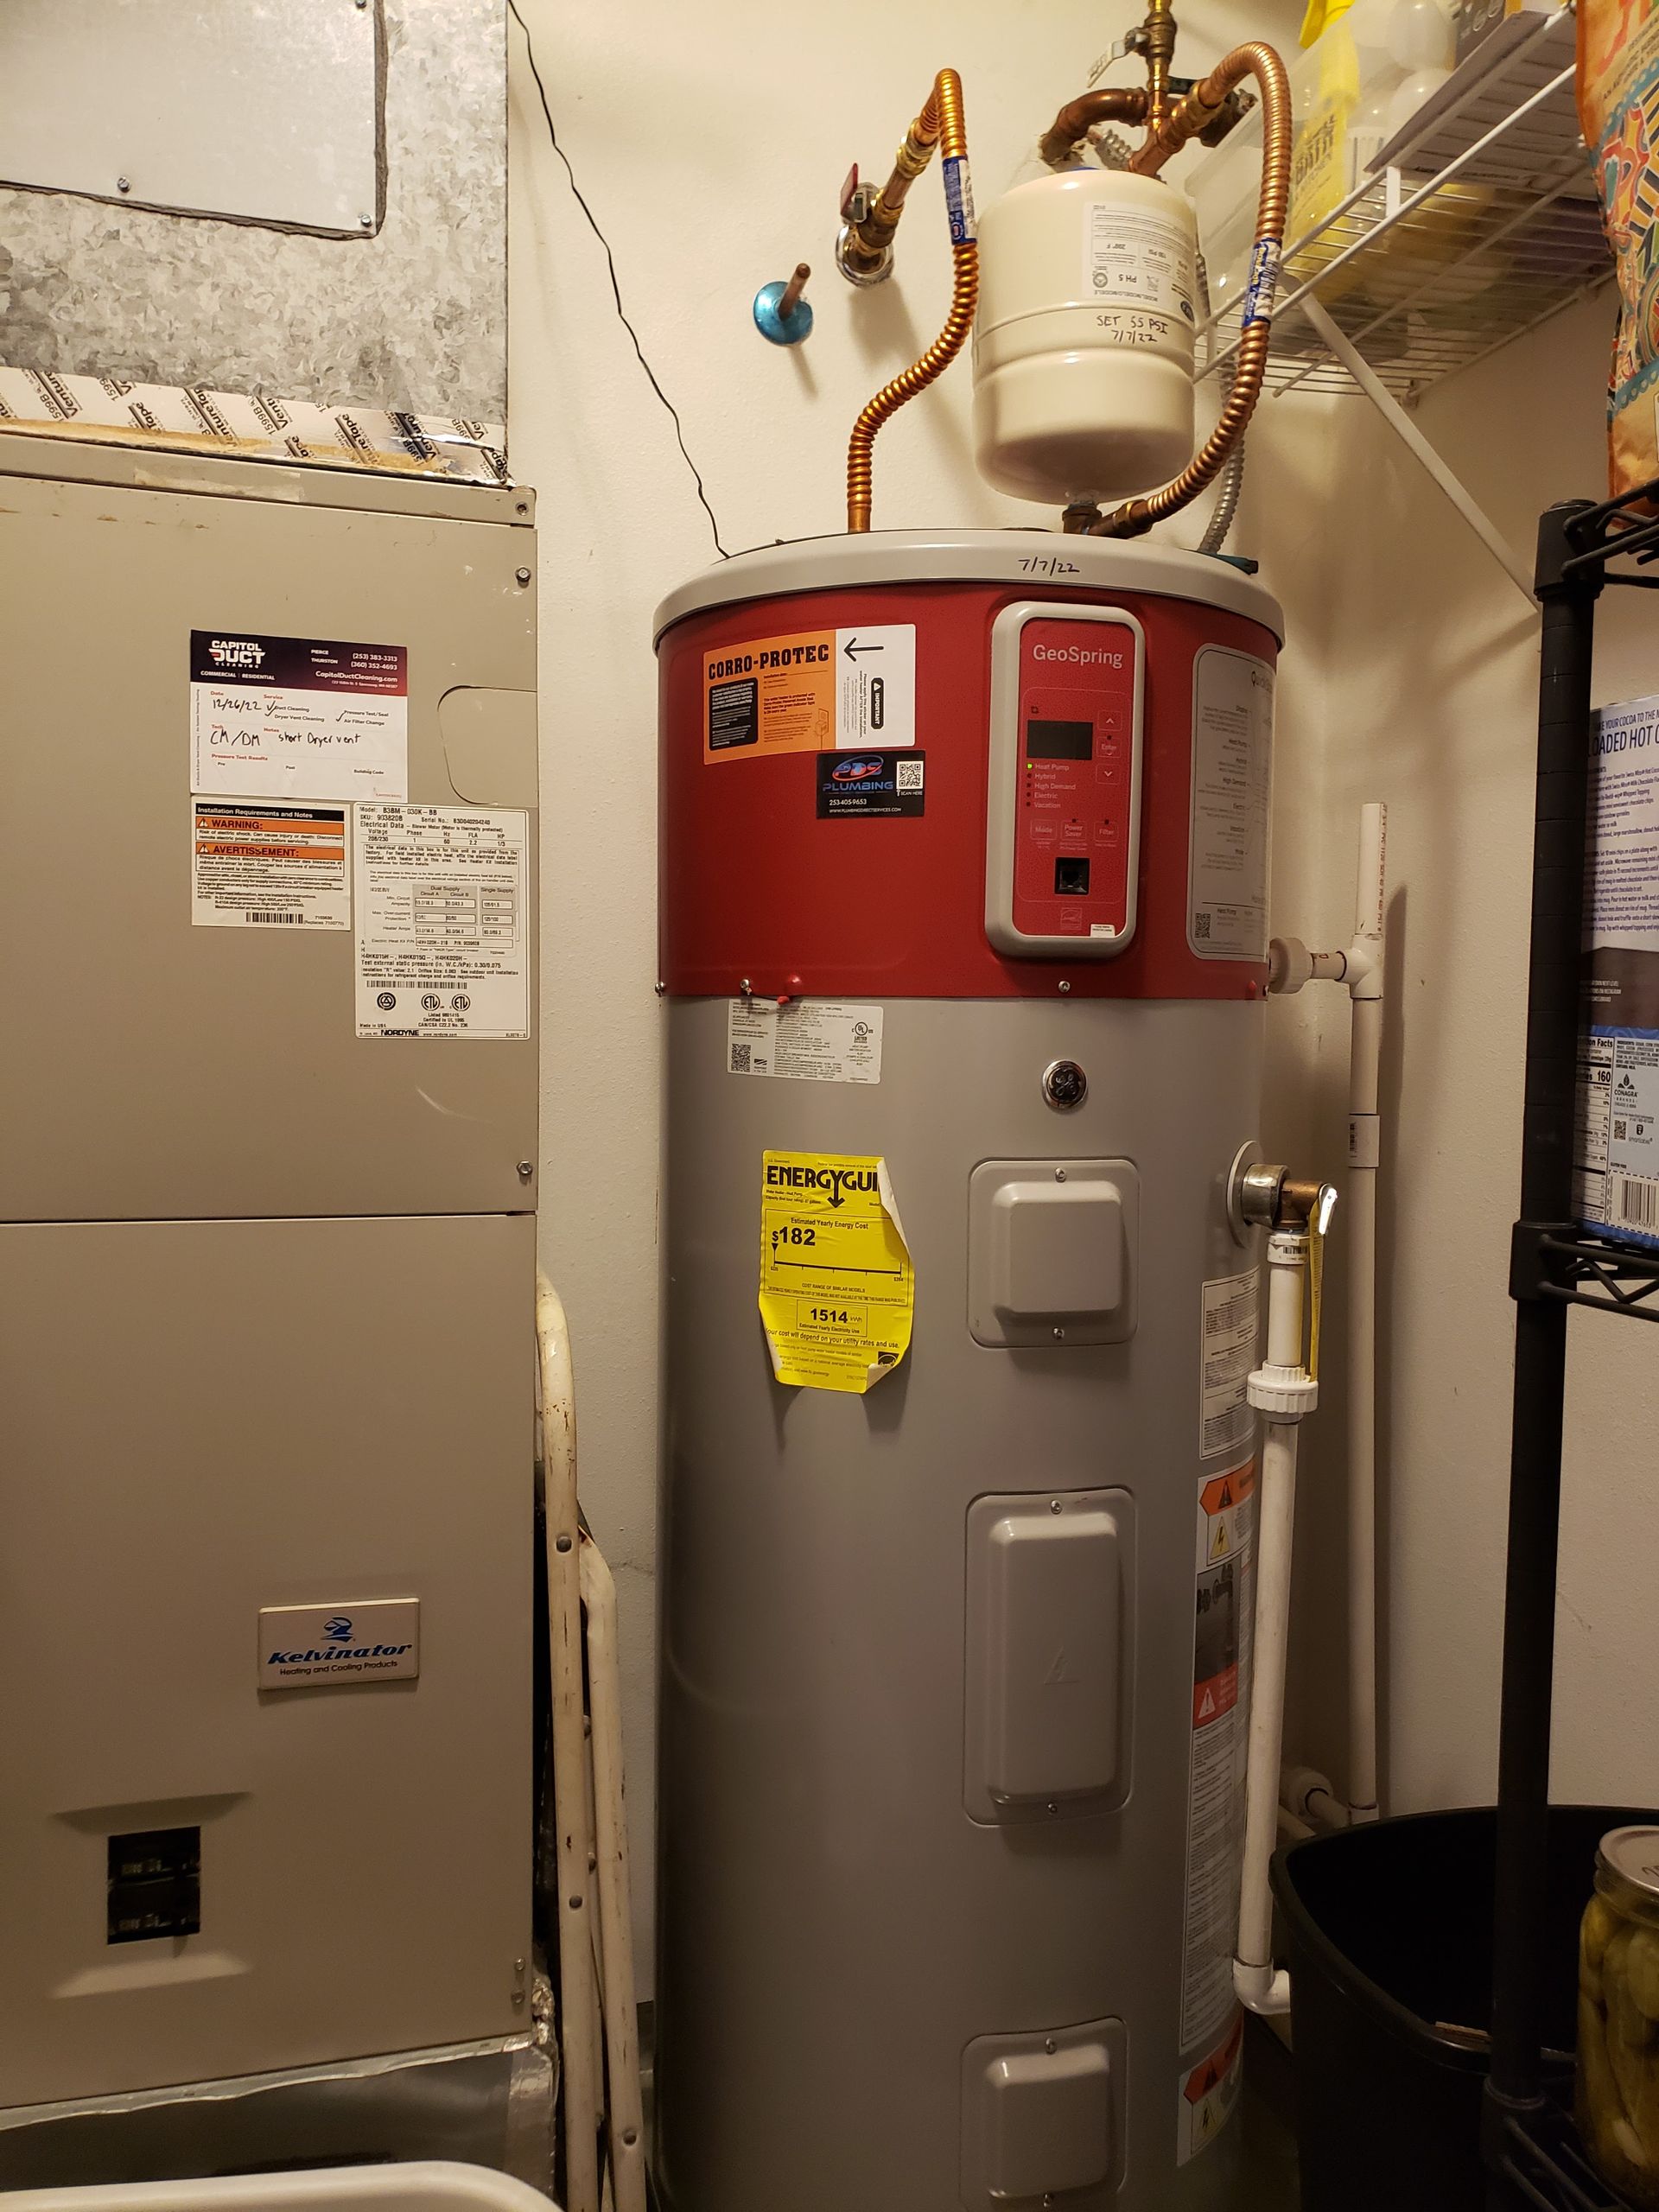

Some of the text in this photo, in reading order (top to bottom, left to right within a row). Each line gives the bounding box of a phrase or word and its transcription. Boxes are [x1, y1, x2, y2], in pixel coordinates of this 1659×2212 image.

[1096, 315, 1168, 334] SET 55 PSI
[1111, 329, 1158, 344] 7/7/22
[39, 392, 65, 422] 1599B
[253, 406, 276, 435] 1599B
[1018, 556, 1080, 576] 7/7/22
[211, 639, 260, 652] CAPITOL
[208, 648, 266, 664] DUCT
[709, 644, 830, 680] CORRO-PROTEC
[1033, 644, 1123, 669] GeoSpring
[315, 671, 398, 683] CapitolDuctCleaning.com
[213, 698, 262, 713] 12/26/22
[1605, 710, 1656, 729] YOUR COCOA TO THE
[278, 732, 360, 747] short Dryer vent
[1592, 725, 1653, 756] OADED HOT
[1101, 743, 1117, 753] Enter
[822, 781, 894, 791] PLUMBING
[197, 806, 234, 815] Installation
[235, 809, 280, 817] Requirements
[212, 819, 263, 830] WARNING:
[213, 845, 300, 857] AVERTISSEMENT:
[1597, 1039, 1612, 1048] Facts
[1598, 1070, 1611, 1082] 160
[1614, 1089, 1638, 1097] CONAGRA
[791, 1217, 816, 1226] Estimated
[817, 1217, 834, 1228] Yearly
[835, 1219, 854, 1230] Energy
[772, 1225, 816, 1247] $182
[810, 1307, 848, 1324] 1514
[831, 1325, 851, 1334] Electricity
[800, 1332, 820, 1342] depend
[829, 1335, 842, 1345] your
[842, 1337, 859, 1347] utility
[267, 1643, 413, 1665] Kelvinator
[279, 1660, 397, 1675] Heating and Cooling Products
